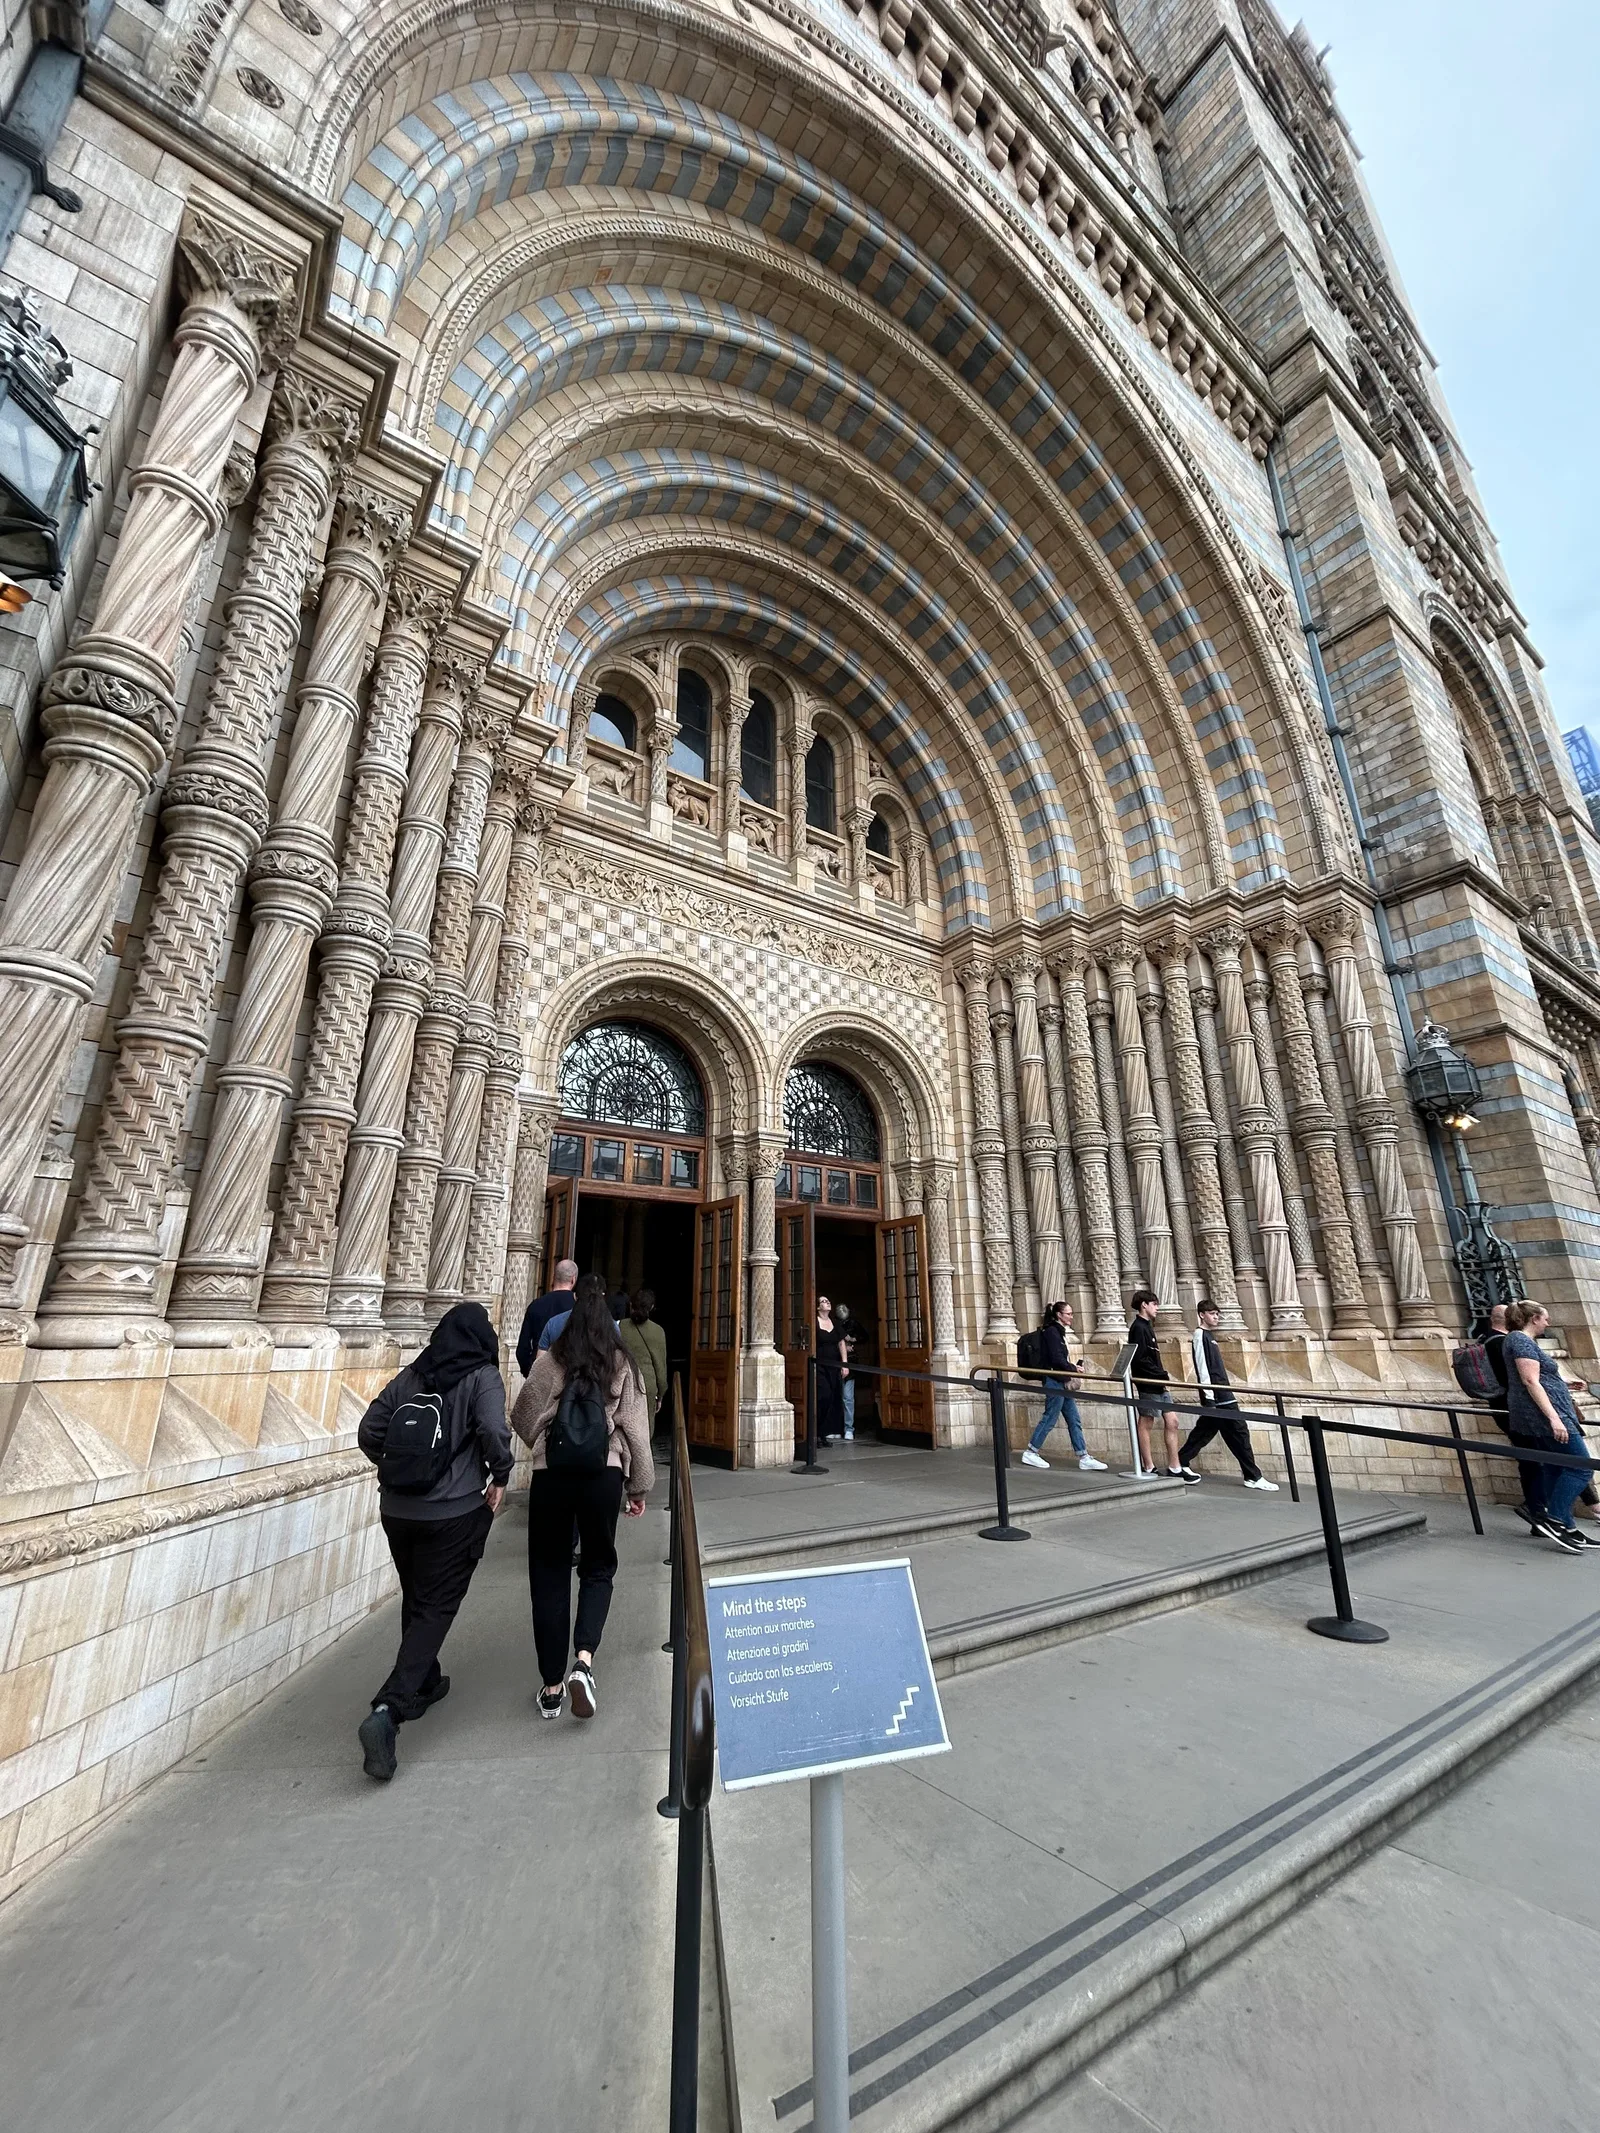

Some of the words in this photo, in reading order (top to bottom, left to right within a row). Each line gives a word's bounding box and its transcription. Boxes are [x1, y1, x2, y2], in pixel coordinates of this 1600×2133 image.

[722, 1598, 752, 1617] Mind
[754, 1597, 774, 1613] the
[776, 1595, 807, 1613] steps
[725, 1624, 763, 1639] Attention
[764, 1623, 780, 1634] aux
[781, 1617, 815, 1632] marches
[727, 1645, 771, 1661] Attenzione
[772, 1643, 780, 1655] ai
[782, 1639, 809, 1657] gradini
[728, 1668, 764, 1685] Cuidado
[765, 1668, 780, 1679] con
[781, 1664, 794, 1676] las
[795, 1660, 833, 1675] escaleras
[730, 1691, 766, 1709] Vorsicht
[766, 1687, 789, 1703] Stufe
